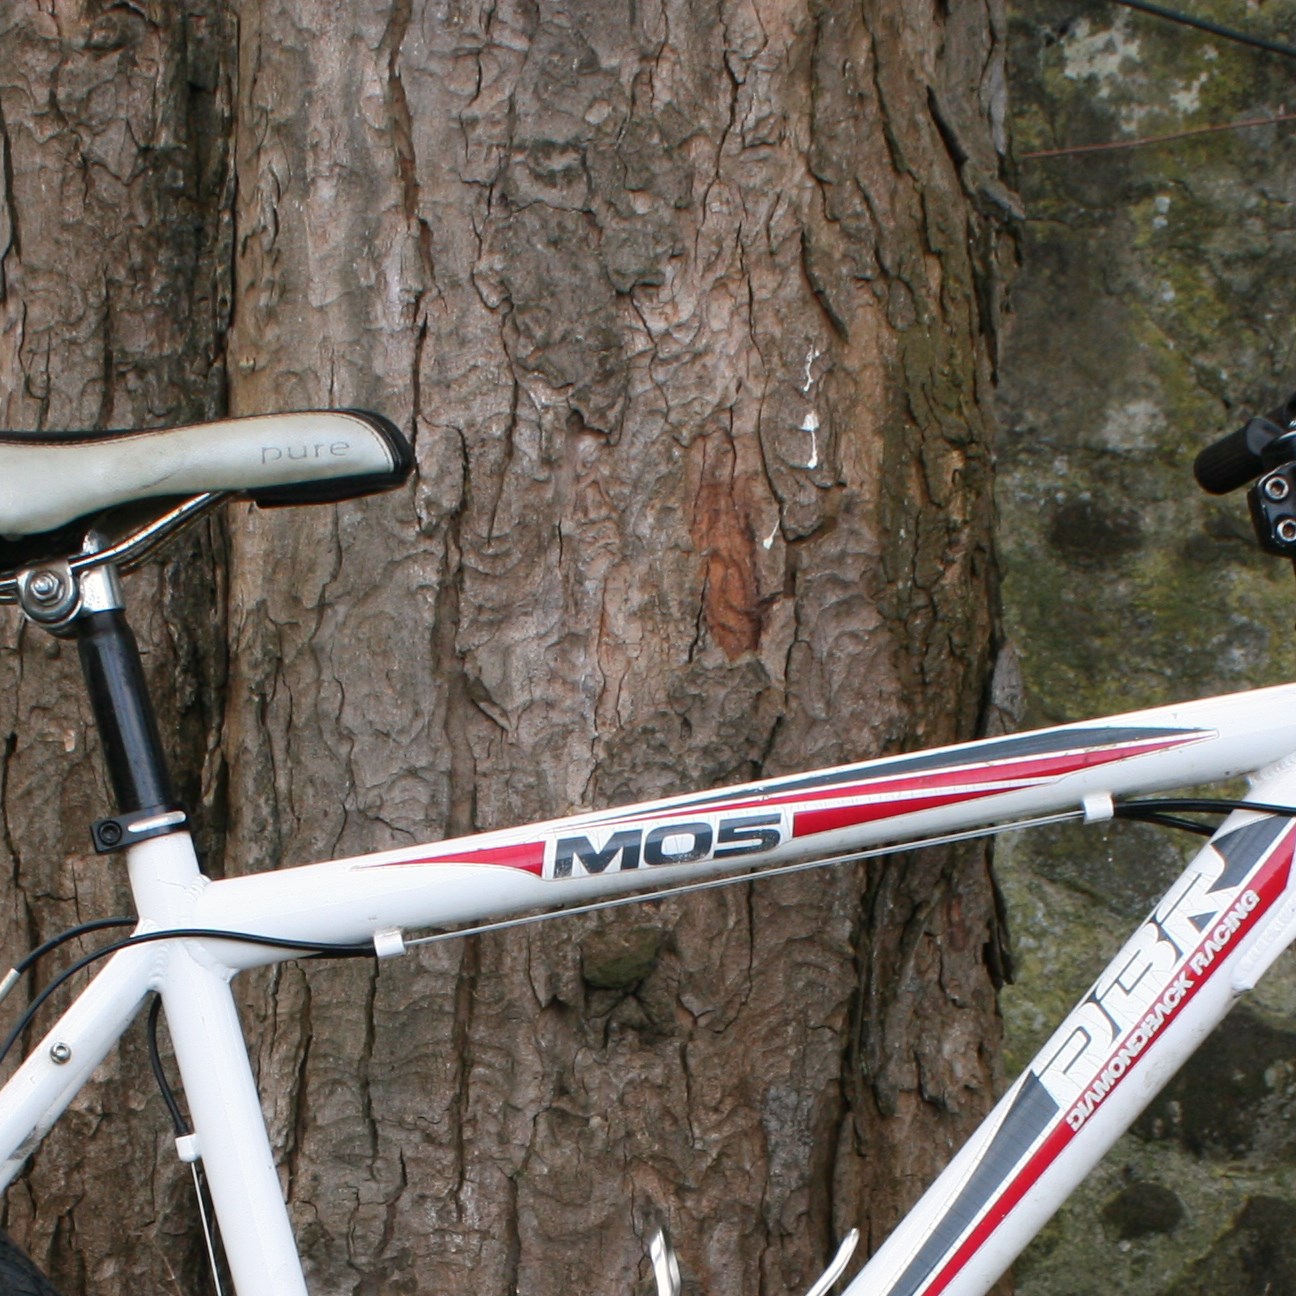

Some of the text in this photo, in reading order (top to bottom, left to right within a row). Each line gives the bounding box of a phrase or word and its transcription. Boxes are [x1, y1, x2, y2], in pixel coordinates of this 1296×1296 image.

[260, 437, 351, 465] pure
[1066, 890, 1260, 1131] DIAMONDBACK RACING
